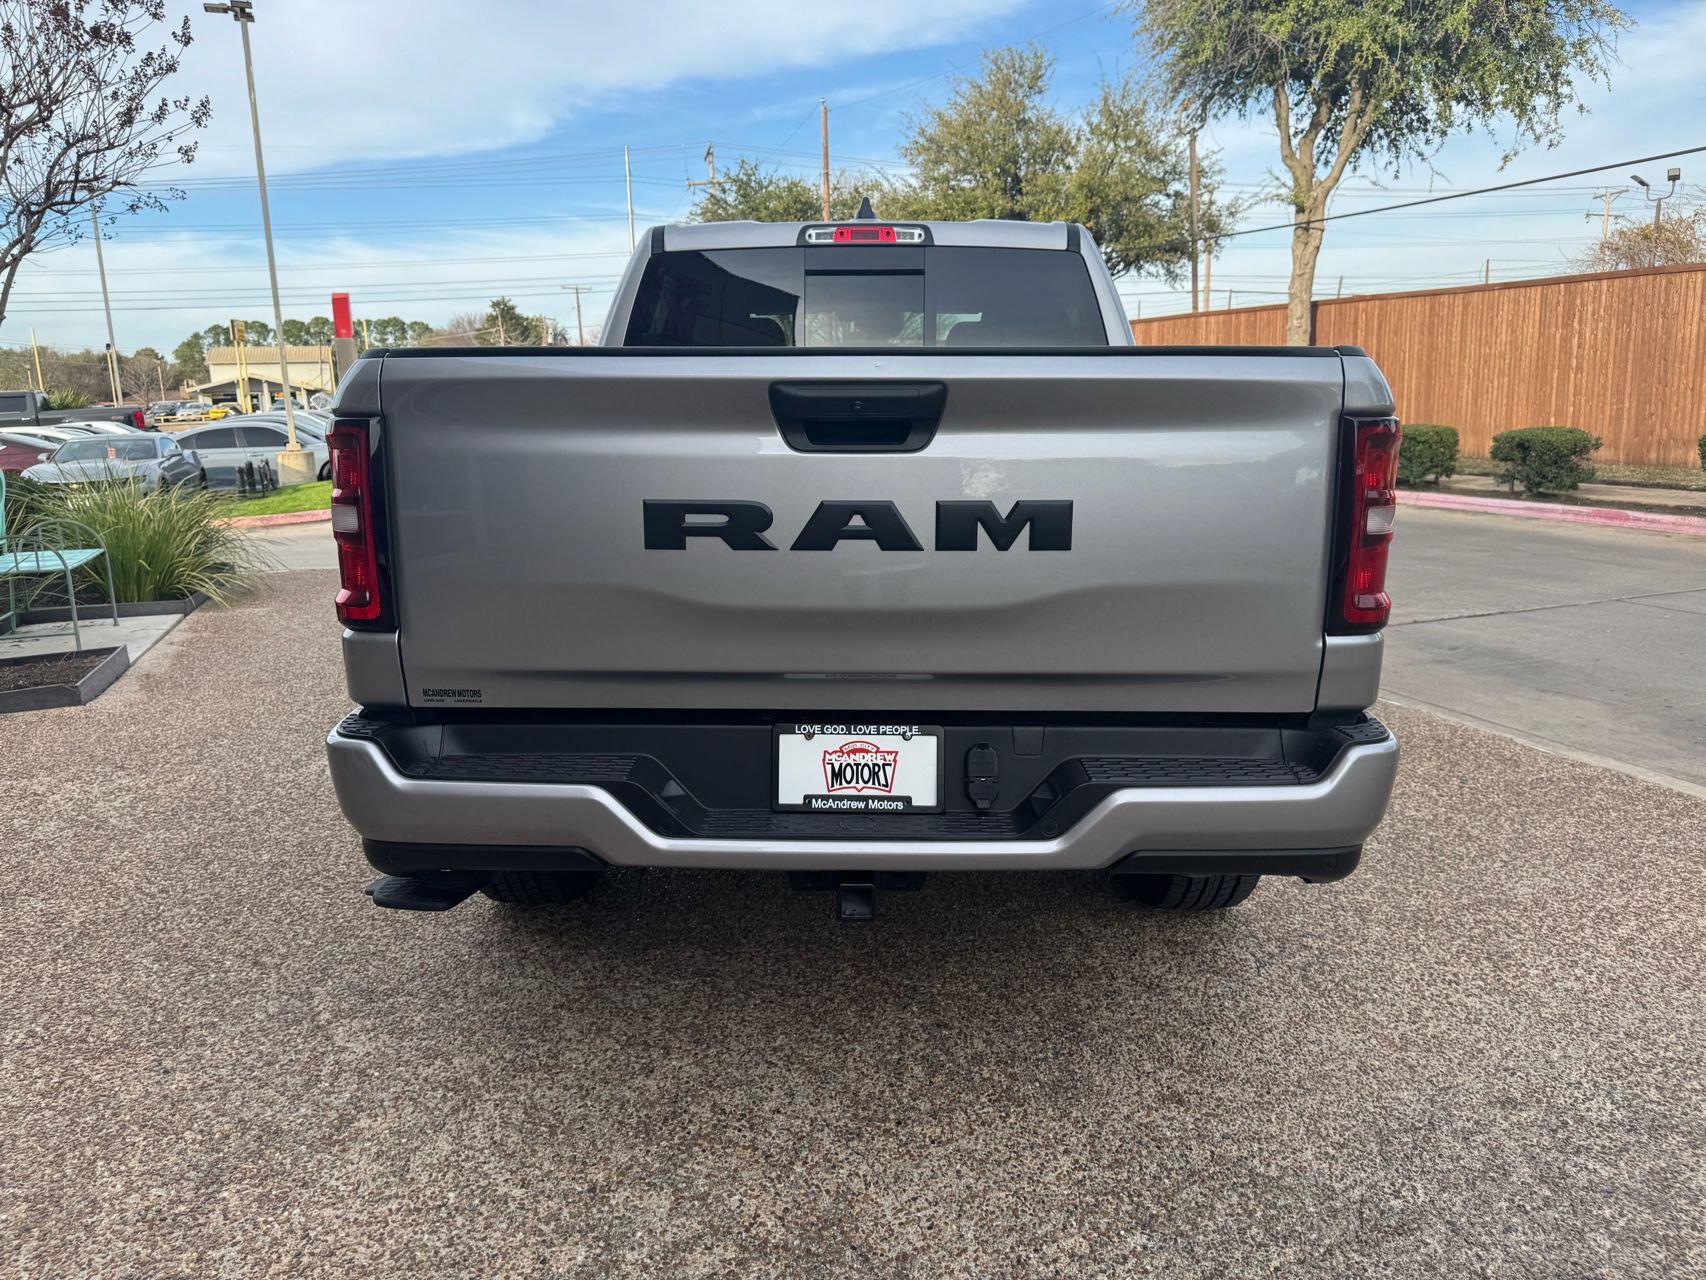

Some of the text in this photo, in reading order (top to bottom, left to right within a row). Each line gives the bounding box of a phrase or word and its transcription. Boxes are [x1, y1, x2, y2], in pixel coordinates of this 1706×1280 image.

[643, 499, 1074, 552] RAM
[457, 689, 482, 698] MOTORS
[795, 725, 921, 735] LOVE GOD. LOVE PEOPLE.
[826, 762, 893, 788] MOTORS
[812, 799, 904, 810] McAndrew Motors
